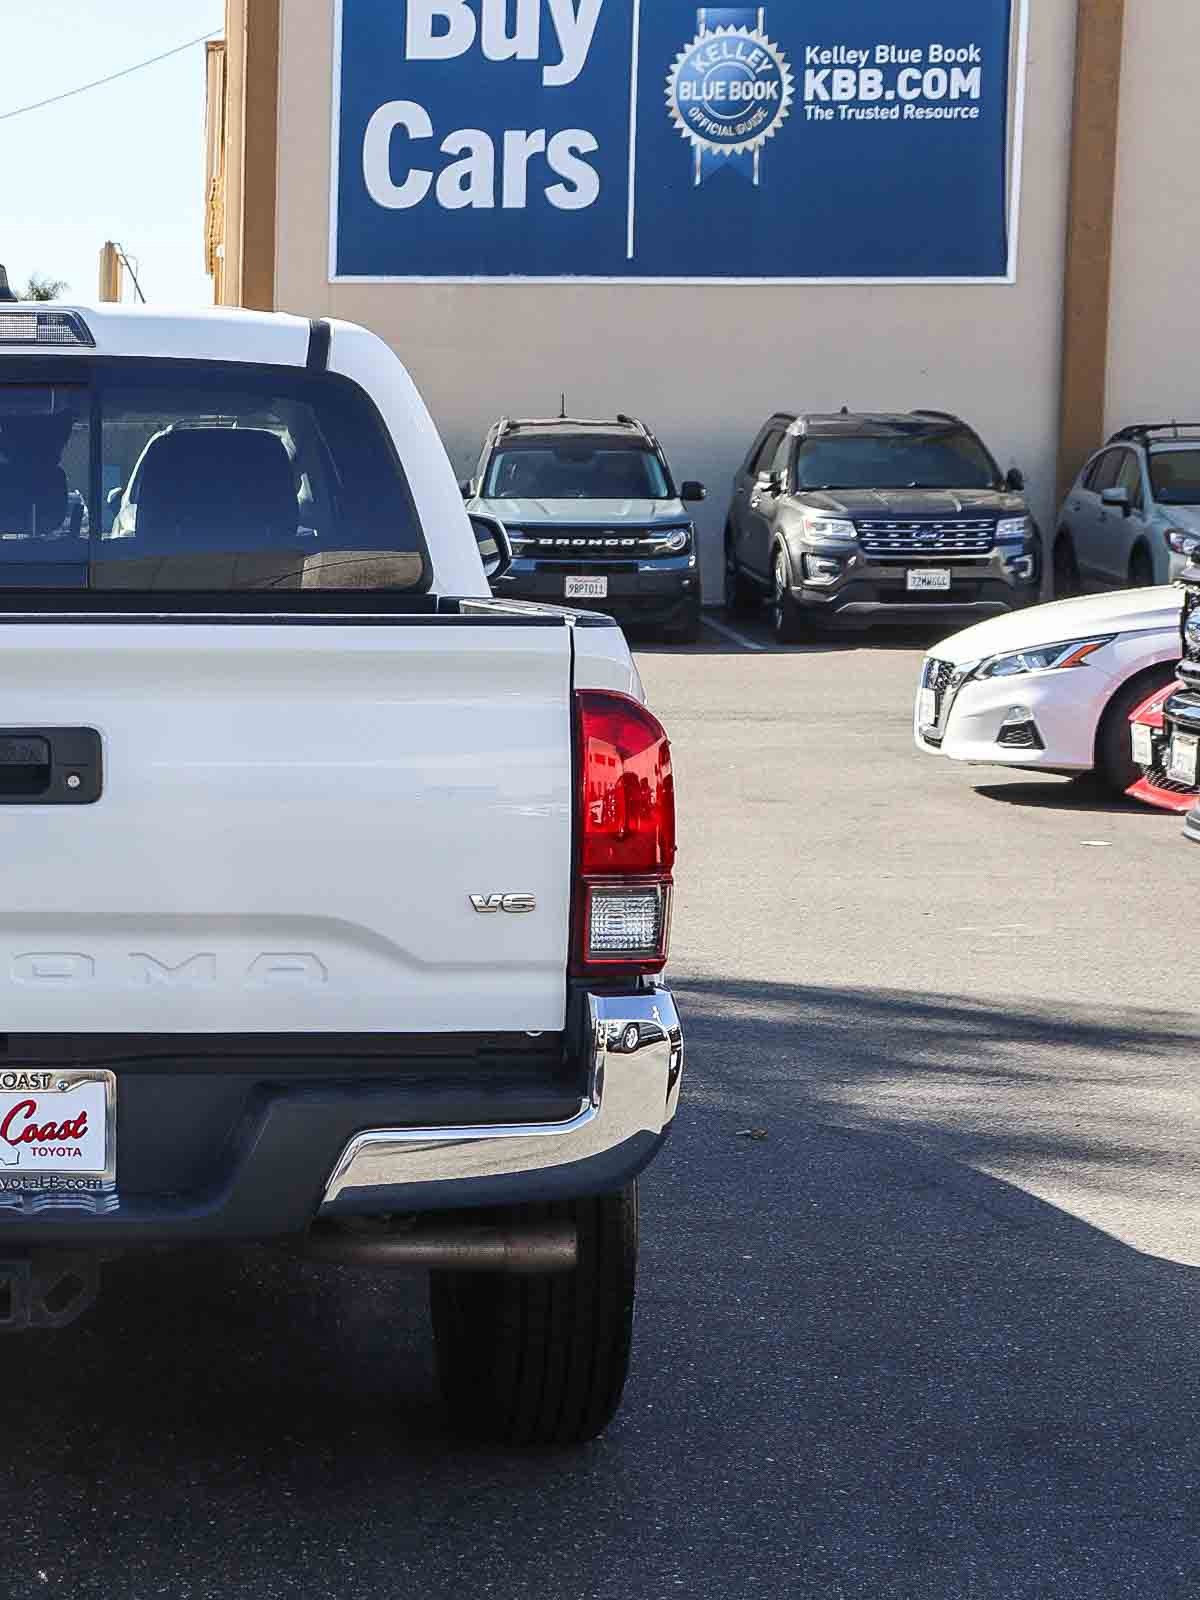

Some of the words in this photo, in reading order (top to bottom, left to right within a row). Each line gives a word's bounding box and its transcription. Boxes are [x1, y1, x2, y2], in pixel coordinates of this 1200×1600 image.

[405, 0, 603, 86] Buy
[690, 40, 773, 75] KELLEY
[805, 46, 869, 68] Kelley
[875, 45, 921, 65] Blue
[929, 44, 982, 64] Book
[679, 80, 726, 101] BLUE
[729, 80, 778, 101] BOOK
[804, 67, 982, 101] KBB.COM
[687, 106, 735, 137] OFFICIAL
[804, 106, 834, 120] The
[838, 105, 899, 120] Trusted
[904, 105, 979, 119] Resource
[362, 100, 600, 209] Cars
[469, 893, 536, 913] V6
[0, 1098, 89, 1146] Coast
[31, 1147, 82, 1157] TOYOTA
